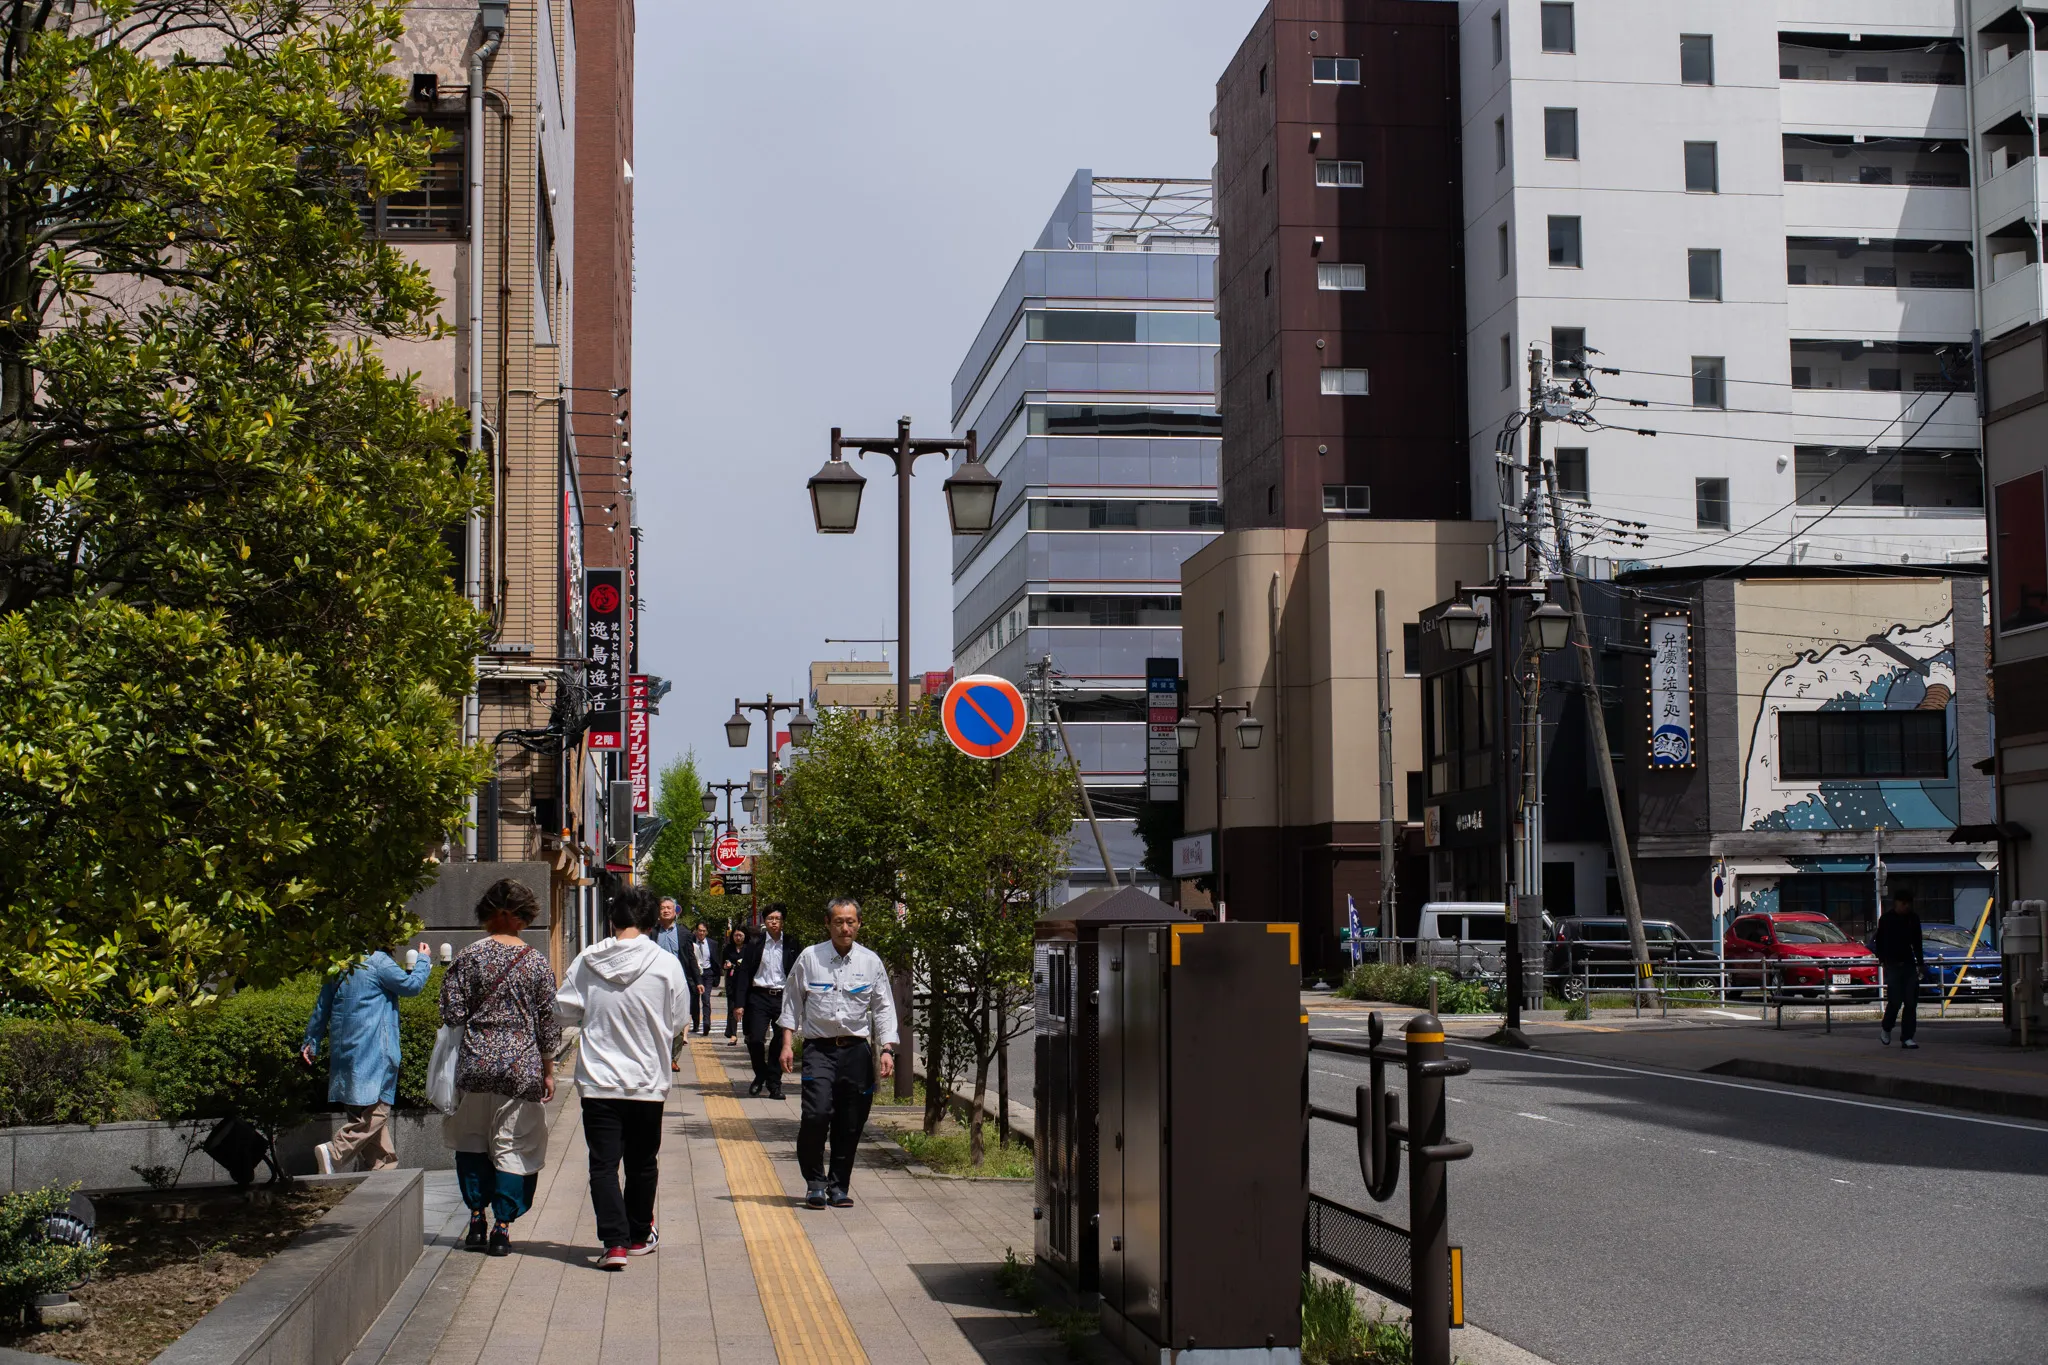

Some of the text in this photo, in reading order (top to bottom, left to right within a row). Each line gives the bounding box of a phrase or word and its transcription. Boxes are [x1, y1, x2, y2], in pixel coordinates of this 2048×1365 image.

[1660, 632, 1680, 718] 弁慶の泣き処
[594, 734, 614, 746] 2階
